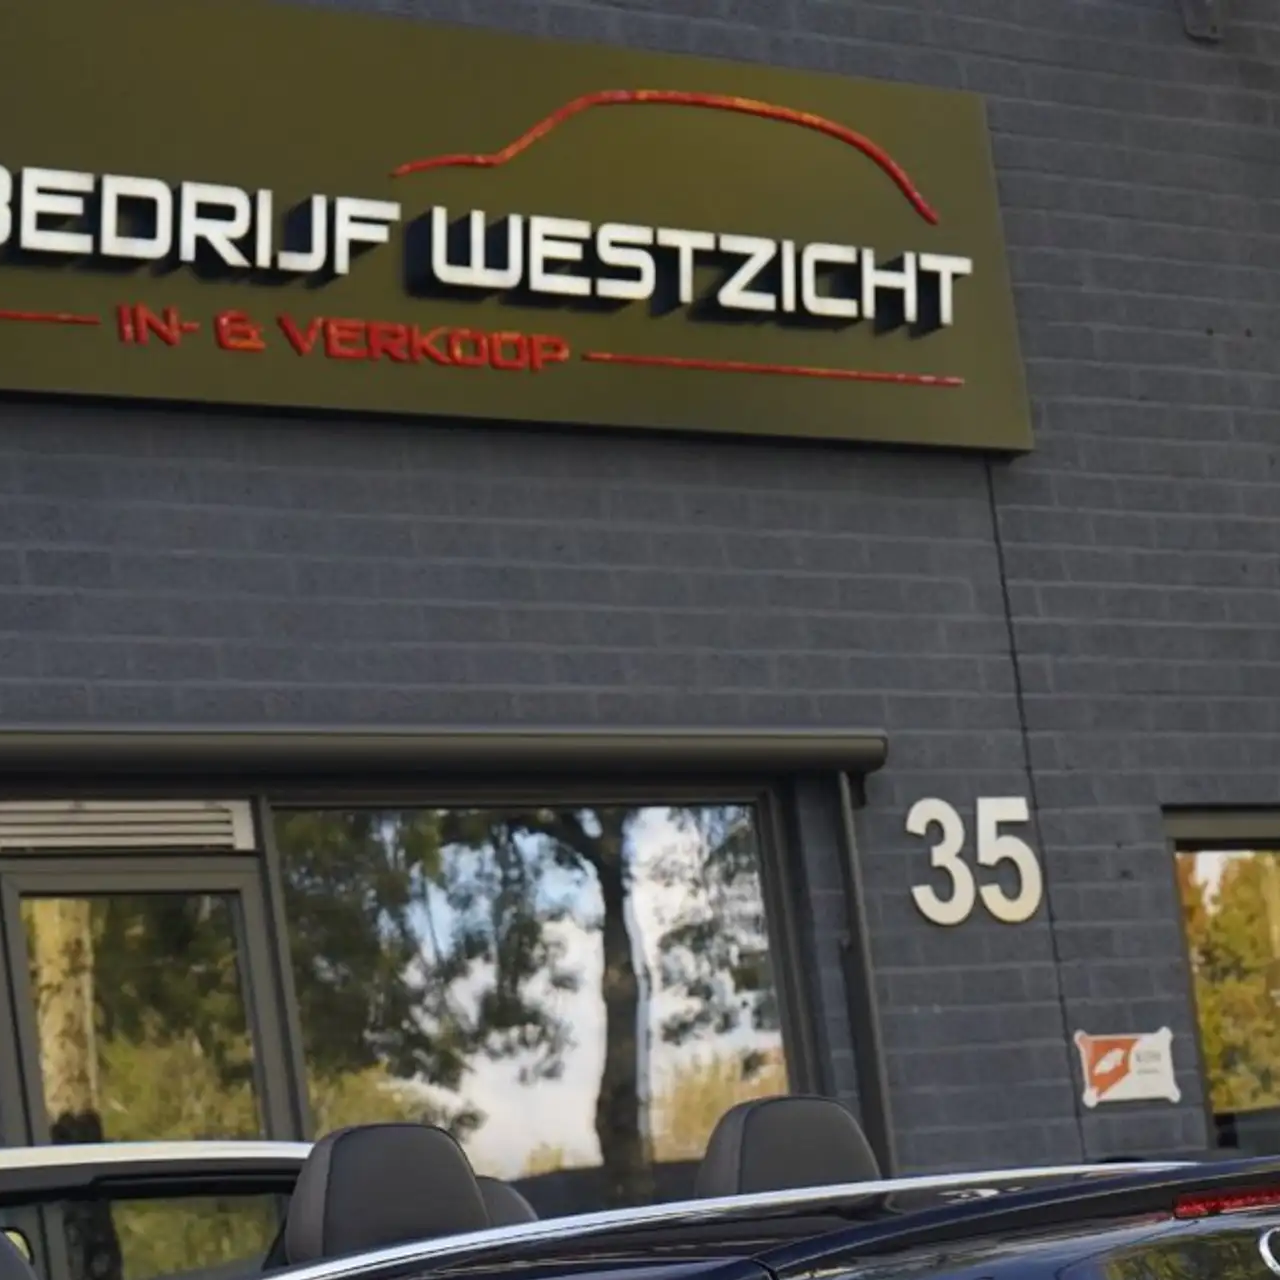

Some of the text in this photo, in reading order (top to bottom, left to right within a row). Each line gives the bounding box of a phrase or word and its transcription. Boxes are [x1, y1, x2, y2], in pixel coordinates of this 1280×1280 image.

[431, 205, 973, 326] WESTZICHT
[118, 302, 570, 371] IN- & VERKOOP
[905, 796, 1043, 926] 35
